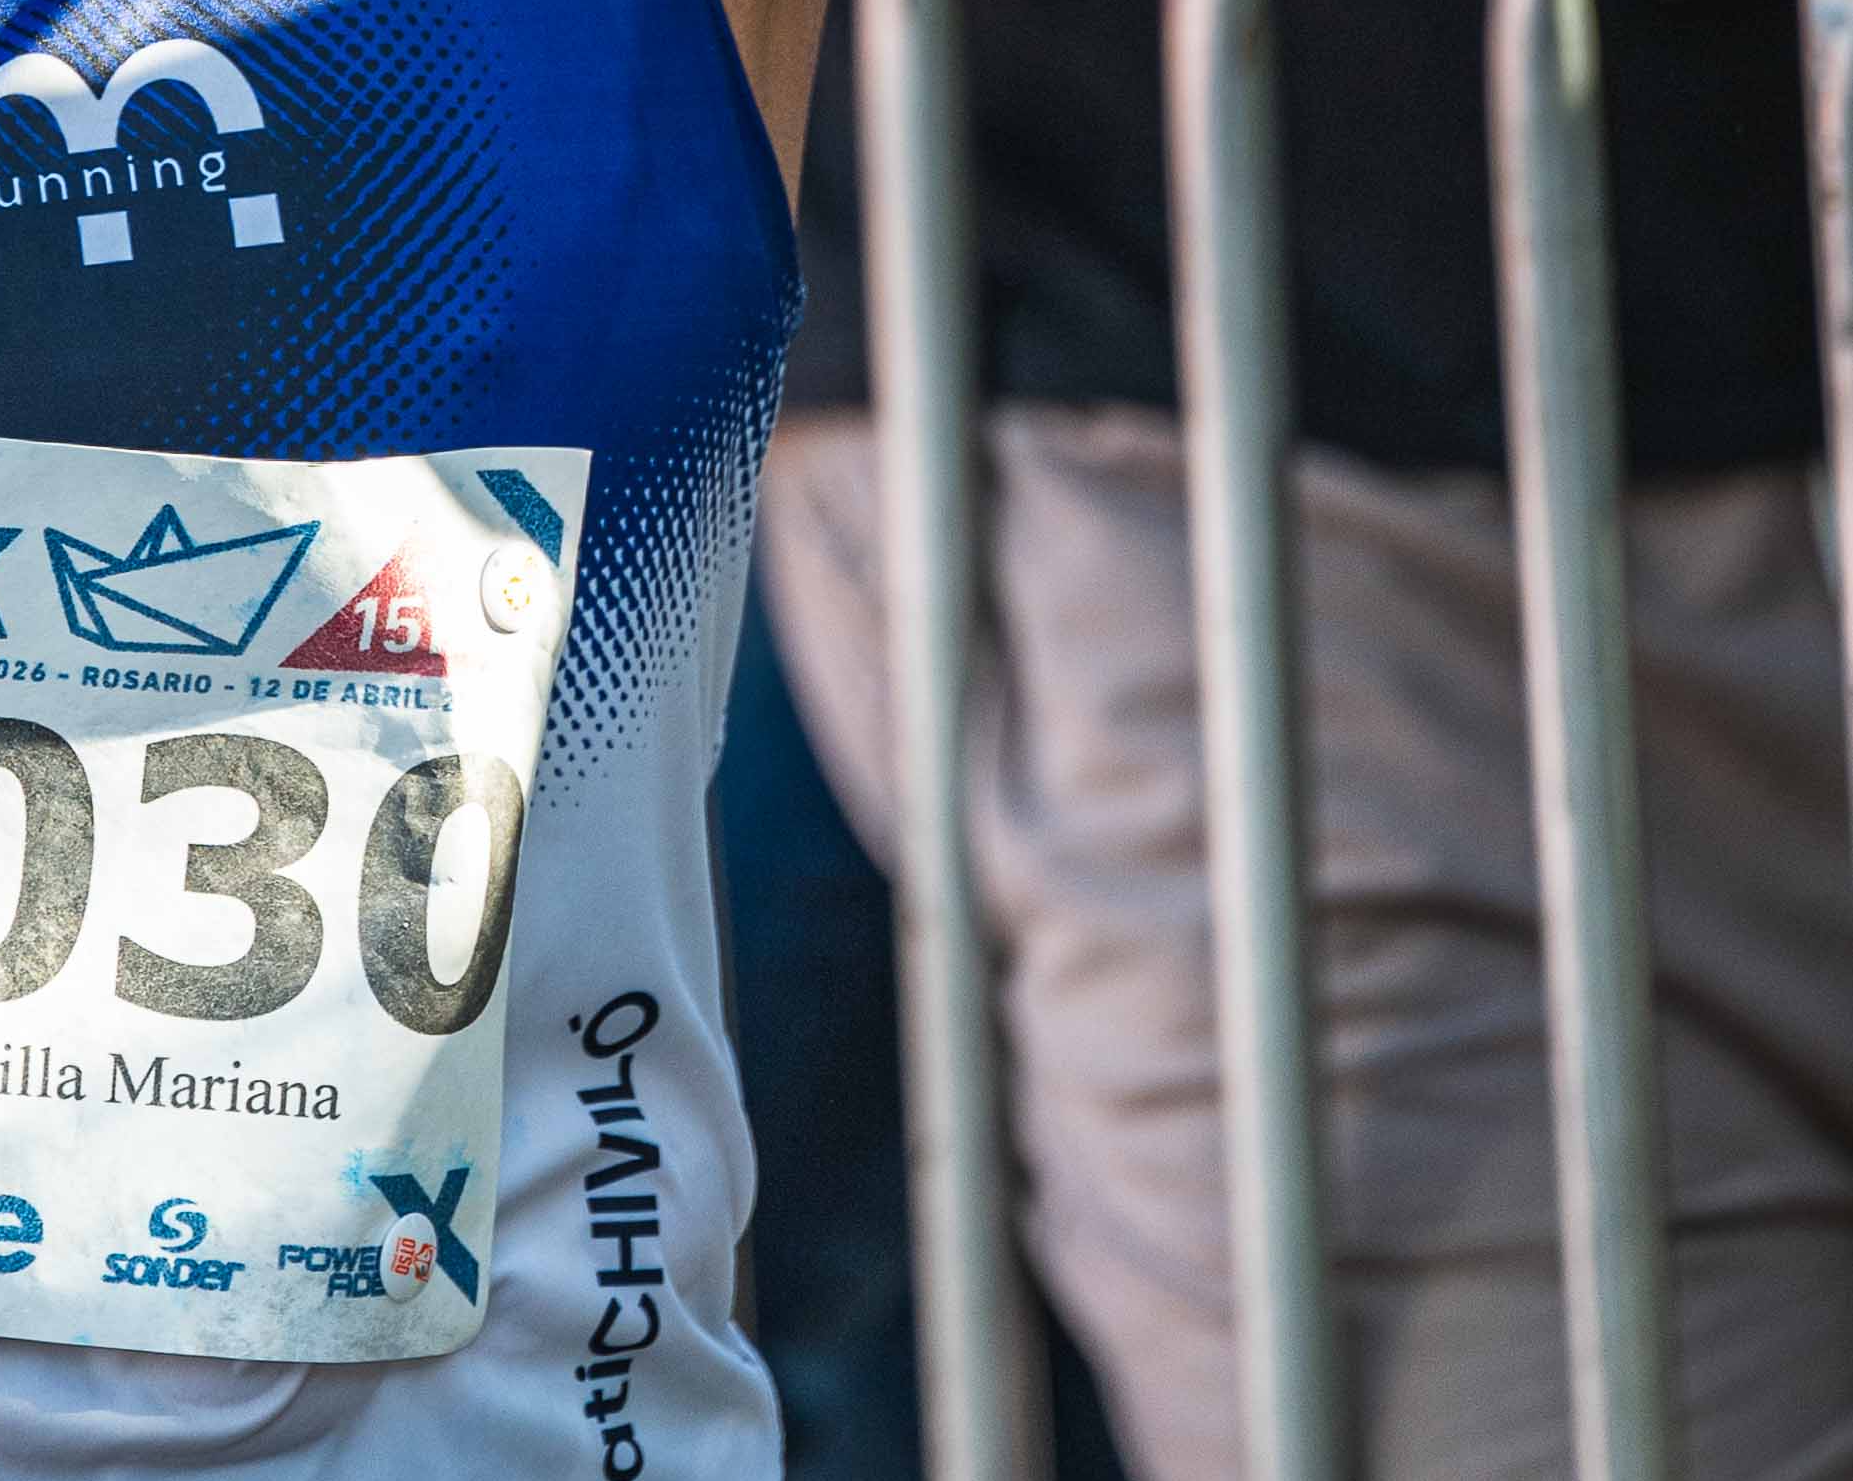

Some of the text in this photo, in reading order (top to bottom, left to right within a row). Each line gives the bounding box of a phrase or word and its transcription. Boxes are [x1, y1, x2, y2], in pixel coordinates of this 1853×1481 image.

[81, 665, 212, 694] ROSARIO
[249, 677, 279, 698] 12
[293, 679, 330, 702] DE
[340, 682, 429, 711] ABRIL
[105, 1052, 340, 1121] Mariana
[395, 1237, 416, 1276] OTSO
